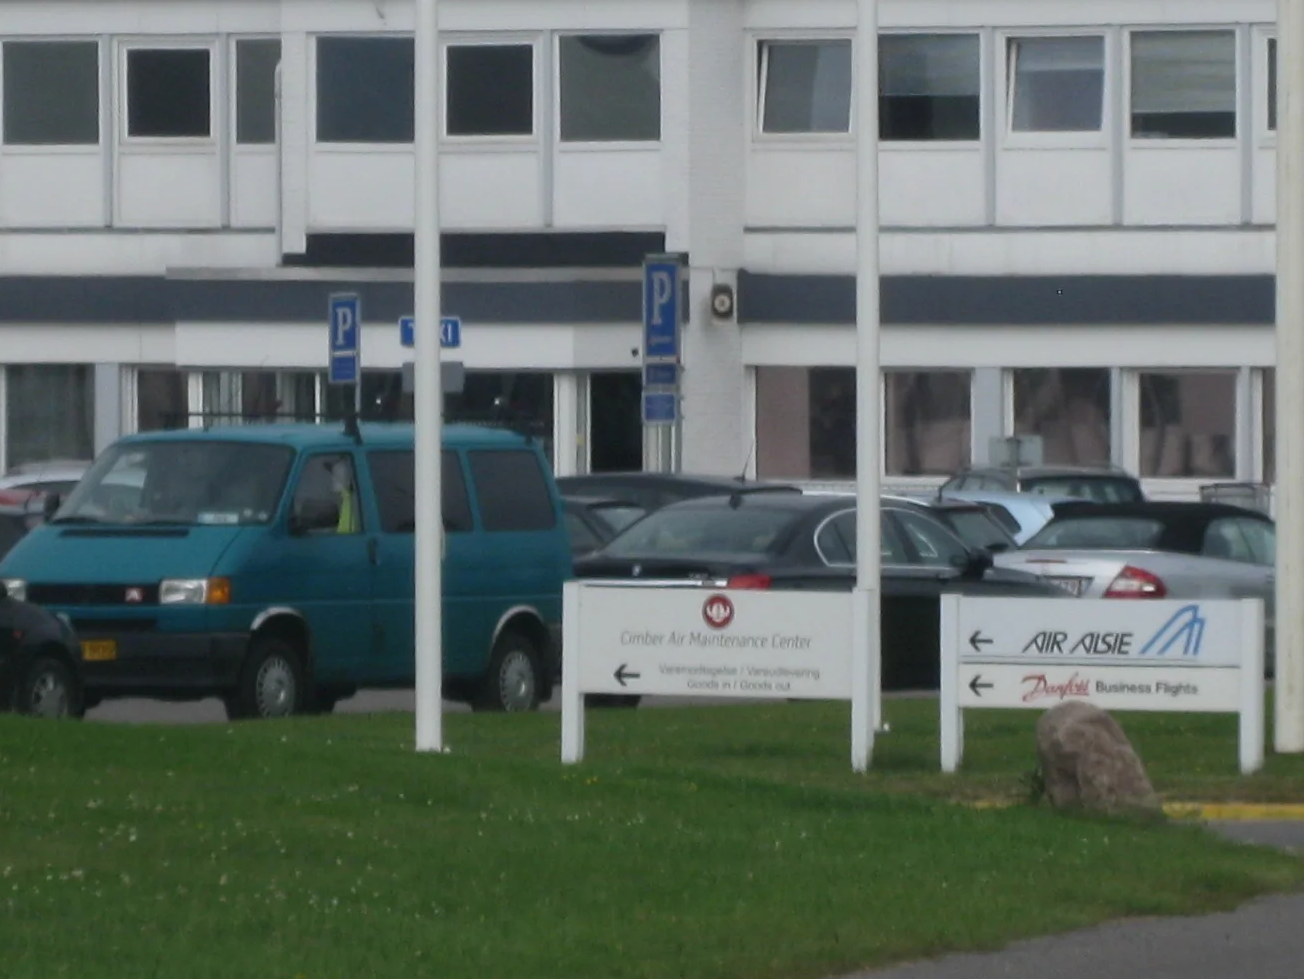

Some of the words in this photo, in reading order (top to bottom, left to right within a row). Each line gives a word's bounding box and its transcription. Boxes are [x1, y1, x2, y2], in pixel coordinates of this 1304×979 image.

[651, 270, 672, 326] P
[334, 306, 353, 346] P
[620, 630, 664, 646] Cimber
[668, 631, 685, 647] Air
[689, 631, 769, 649] Maintenance
[771, 633, 812, 650] Center
[1021, 630, 1068, 654] AIR
[1069, 631, 1134, 655] ALSIE
[1095, 680, 1152, 694] Business
[1155, 680, 1199, 698] Flights
